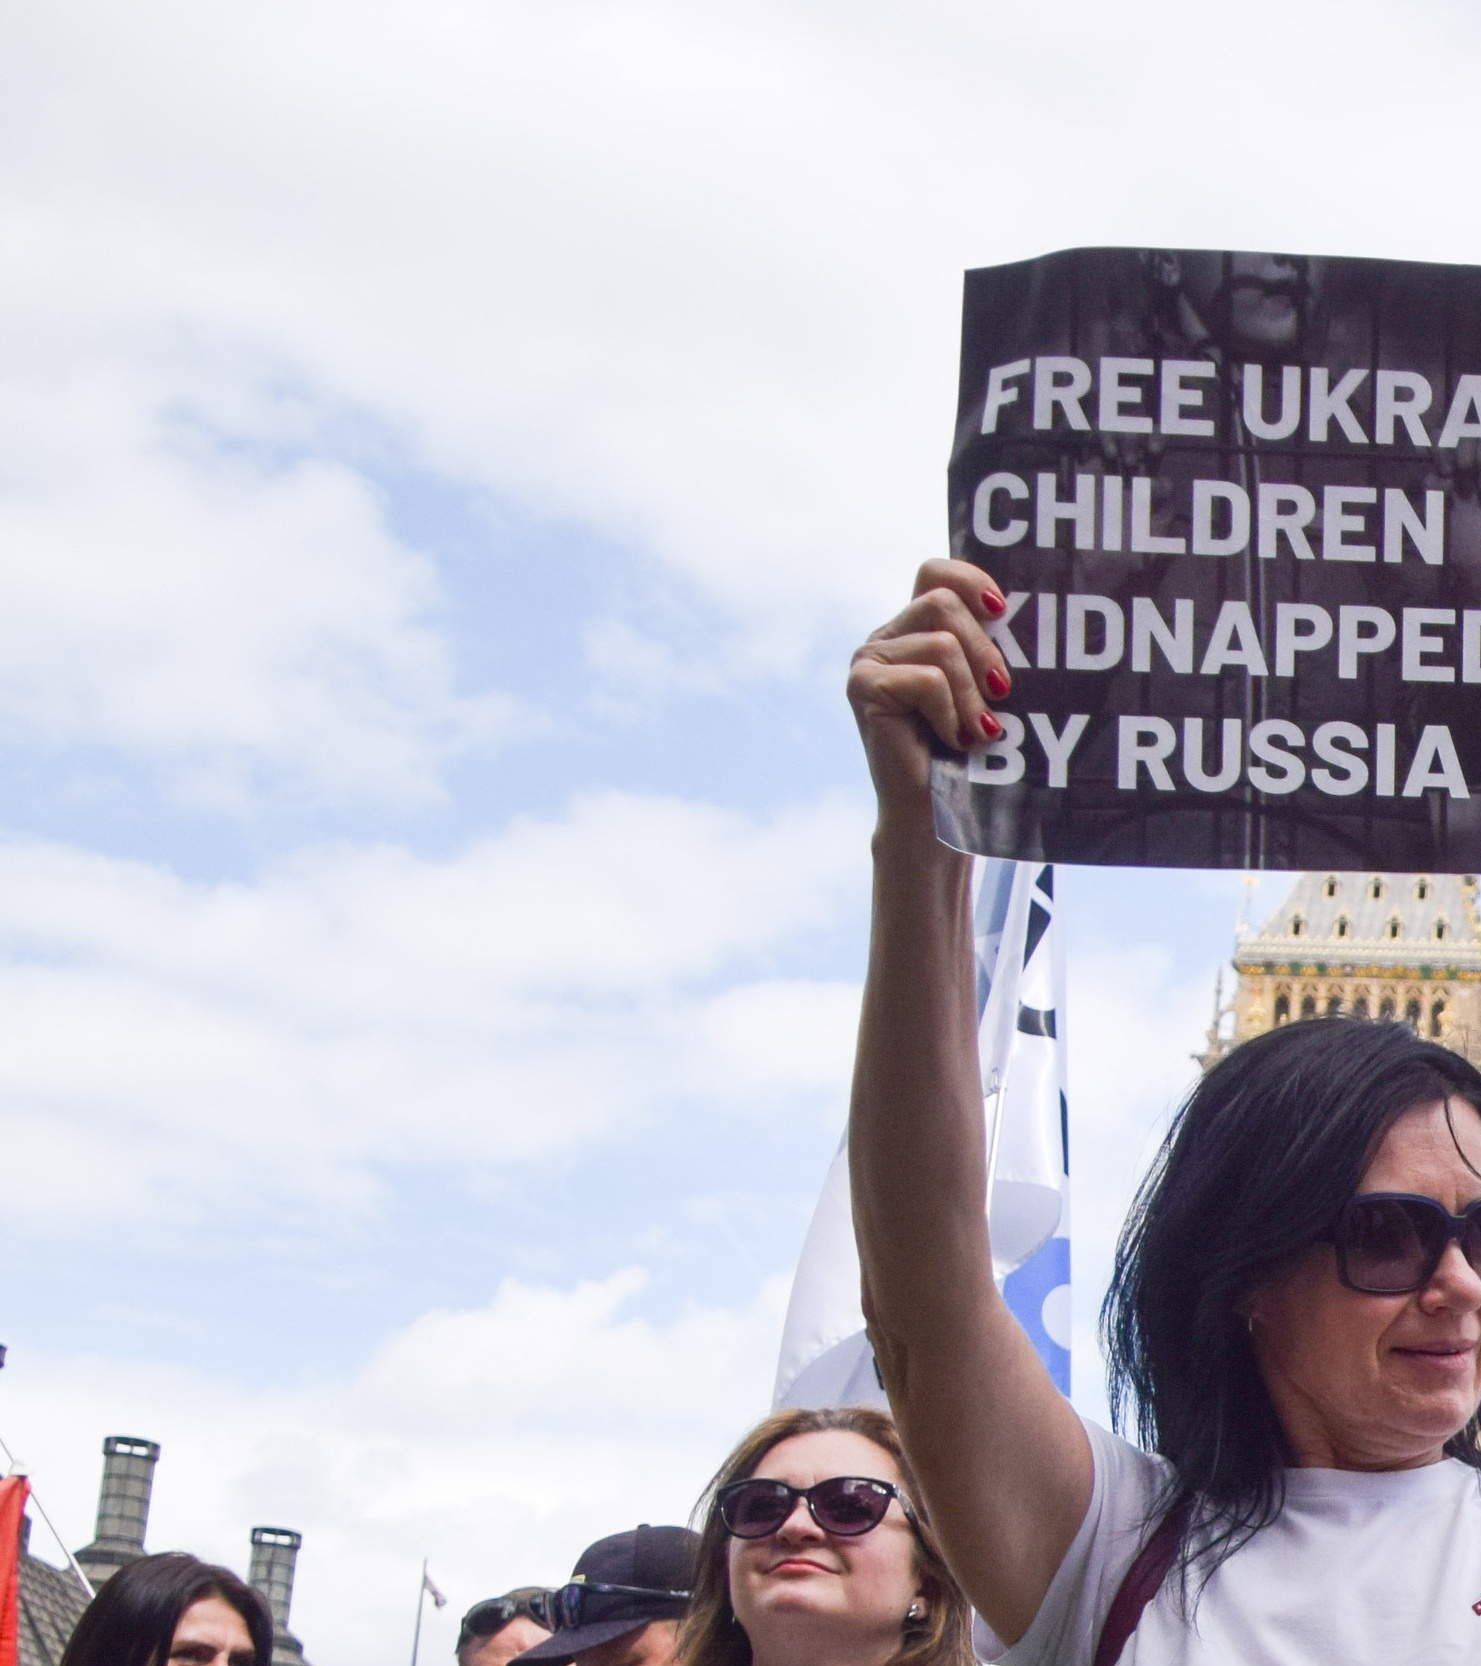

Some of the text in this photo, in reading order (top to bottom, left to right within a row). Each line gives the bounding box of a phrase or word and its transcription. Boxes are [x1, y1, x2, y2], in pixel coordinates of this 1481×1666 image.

[979, 356, 1216, 437] FREE
[972, 472, 1445, 565] CHILDREN
[968, 711, 1471, 799] BY RUSSIA
